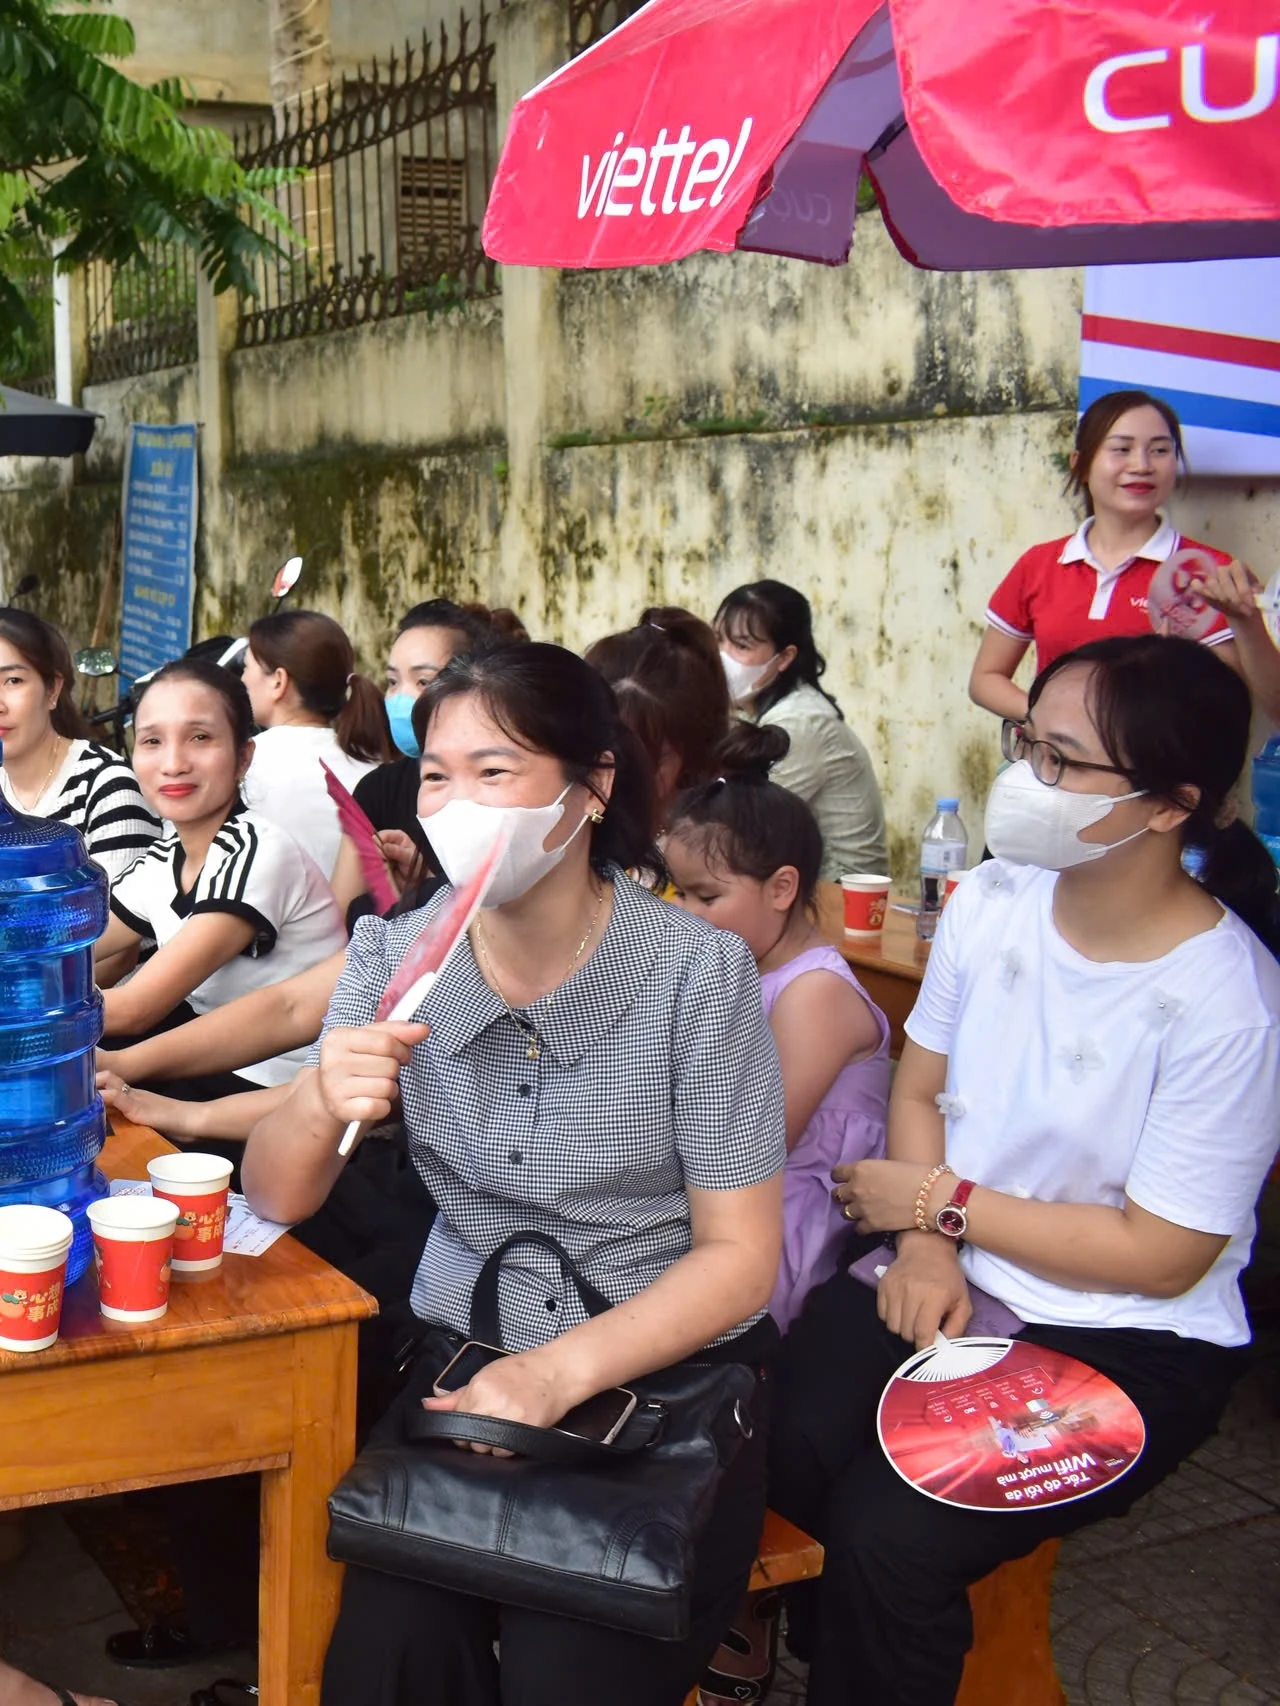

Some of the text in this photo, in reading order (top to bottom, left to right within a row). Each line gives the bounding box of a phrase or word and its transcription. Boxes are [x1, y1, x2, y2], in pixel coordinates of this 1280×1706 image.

[577, 116, 754, 219] viettel
[996, 1452, 1097, 1487] Wifi mượt mà
[1043, 1478, 1062, 1492] độ
[1063, 1471, 1091, 1488] Tốc
[1023, 1483, 1044, 1500] tối
